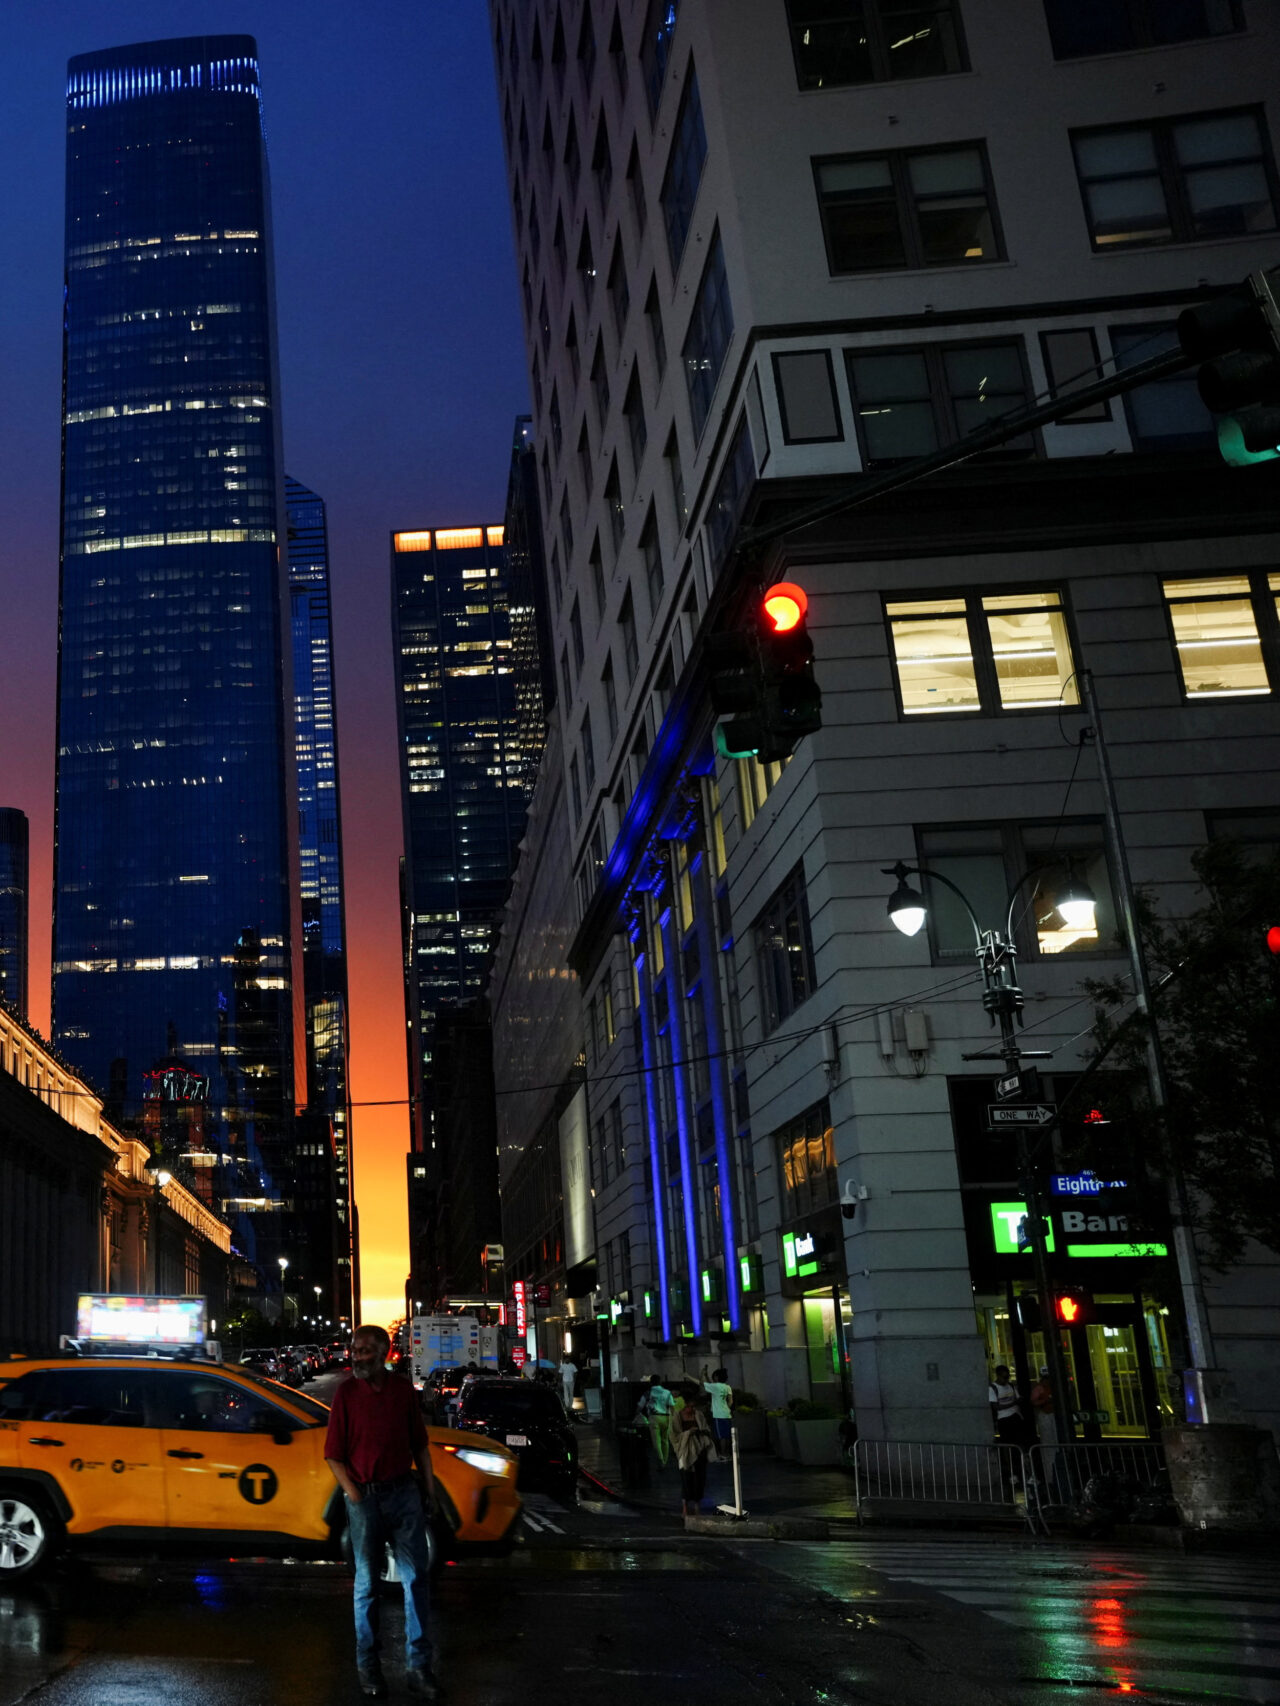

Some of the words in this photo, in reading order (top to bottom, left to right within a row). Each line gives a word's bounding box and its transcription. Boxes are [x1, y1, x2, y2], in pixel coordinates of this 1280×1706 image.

[999, 1111, 1017, 1119] ONE
[1026, 1111, 1047, 1119] WAY
[1061, 1211, 1129, 1233] Ban
[515, 1293, 525, 1327] PARK
